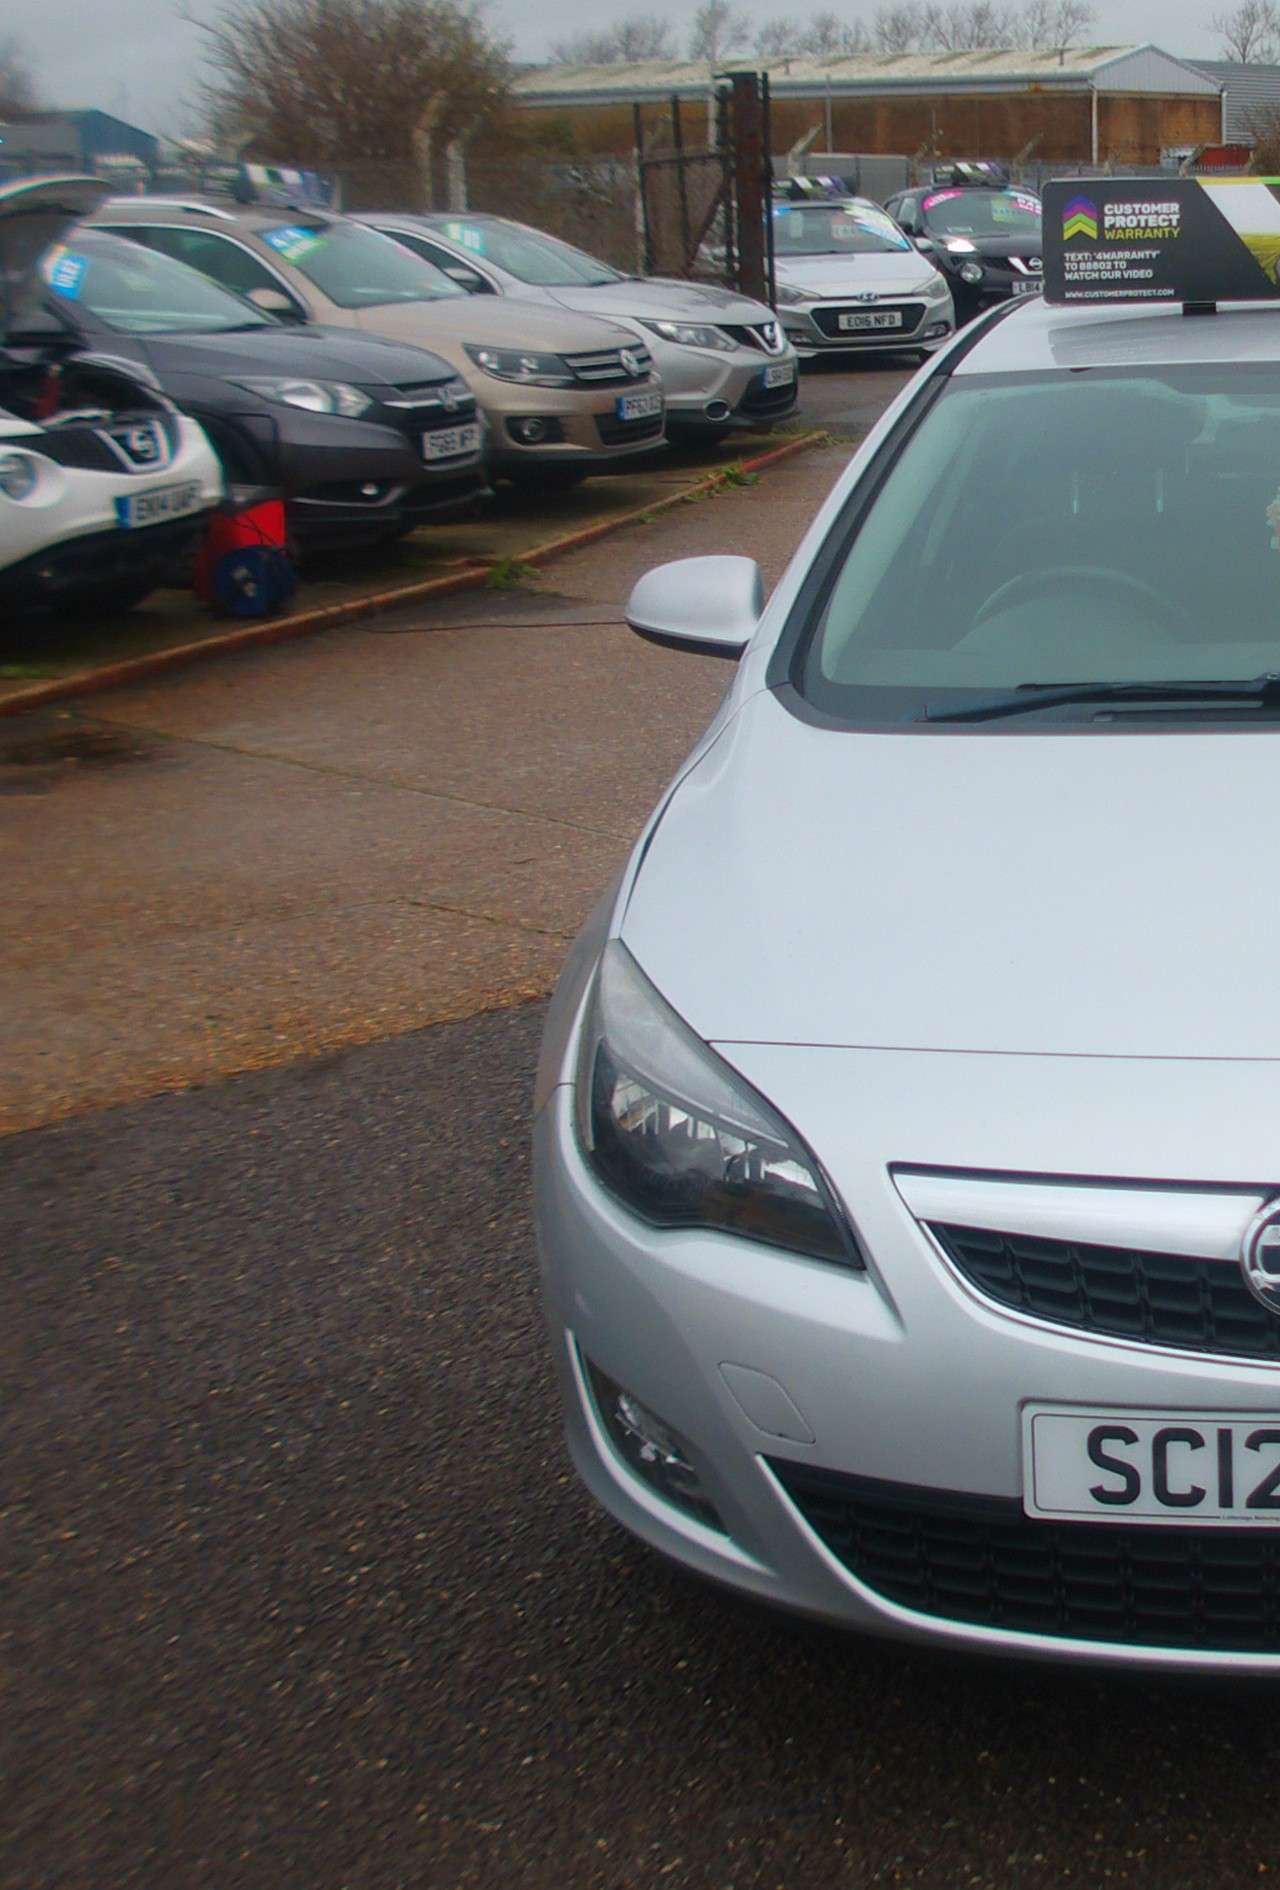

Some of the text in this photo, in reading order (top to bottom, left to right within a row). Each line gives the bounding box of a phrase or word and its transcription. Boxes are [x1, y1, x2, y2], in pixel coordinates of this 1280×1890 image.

[1104, 203, 1180, 215] CUSTOMER
[1104, 214, 1180, 228] PROTECT
[1104, 227, 1180, 240] WARRANTY
[1064, 262, 1078, 271] TO
[1114, 260, 1128, 270] TO
[1064, 269, 1154, 281] WATCH OUR VIDEO
